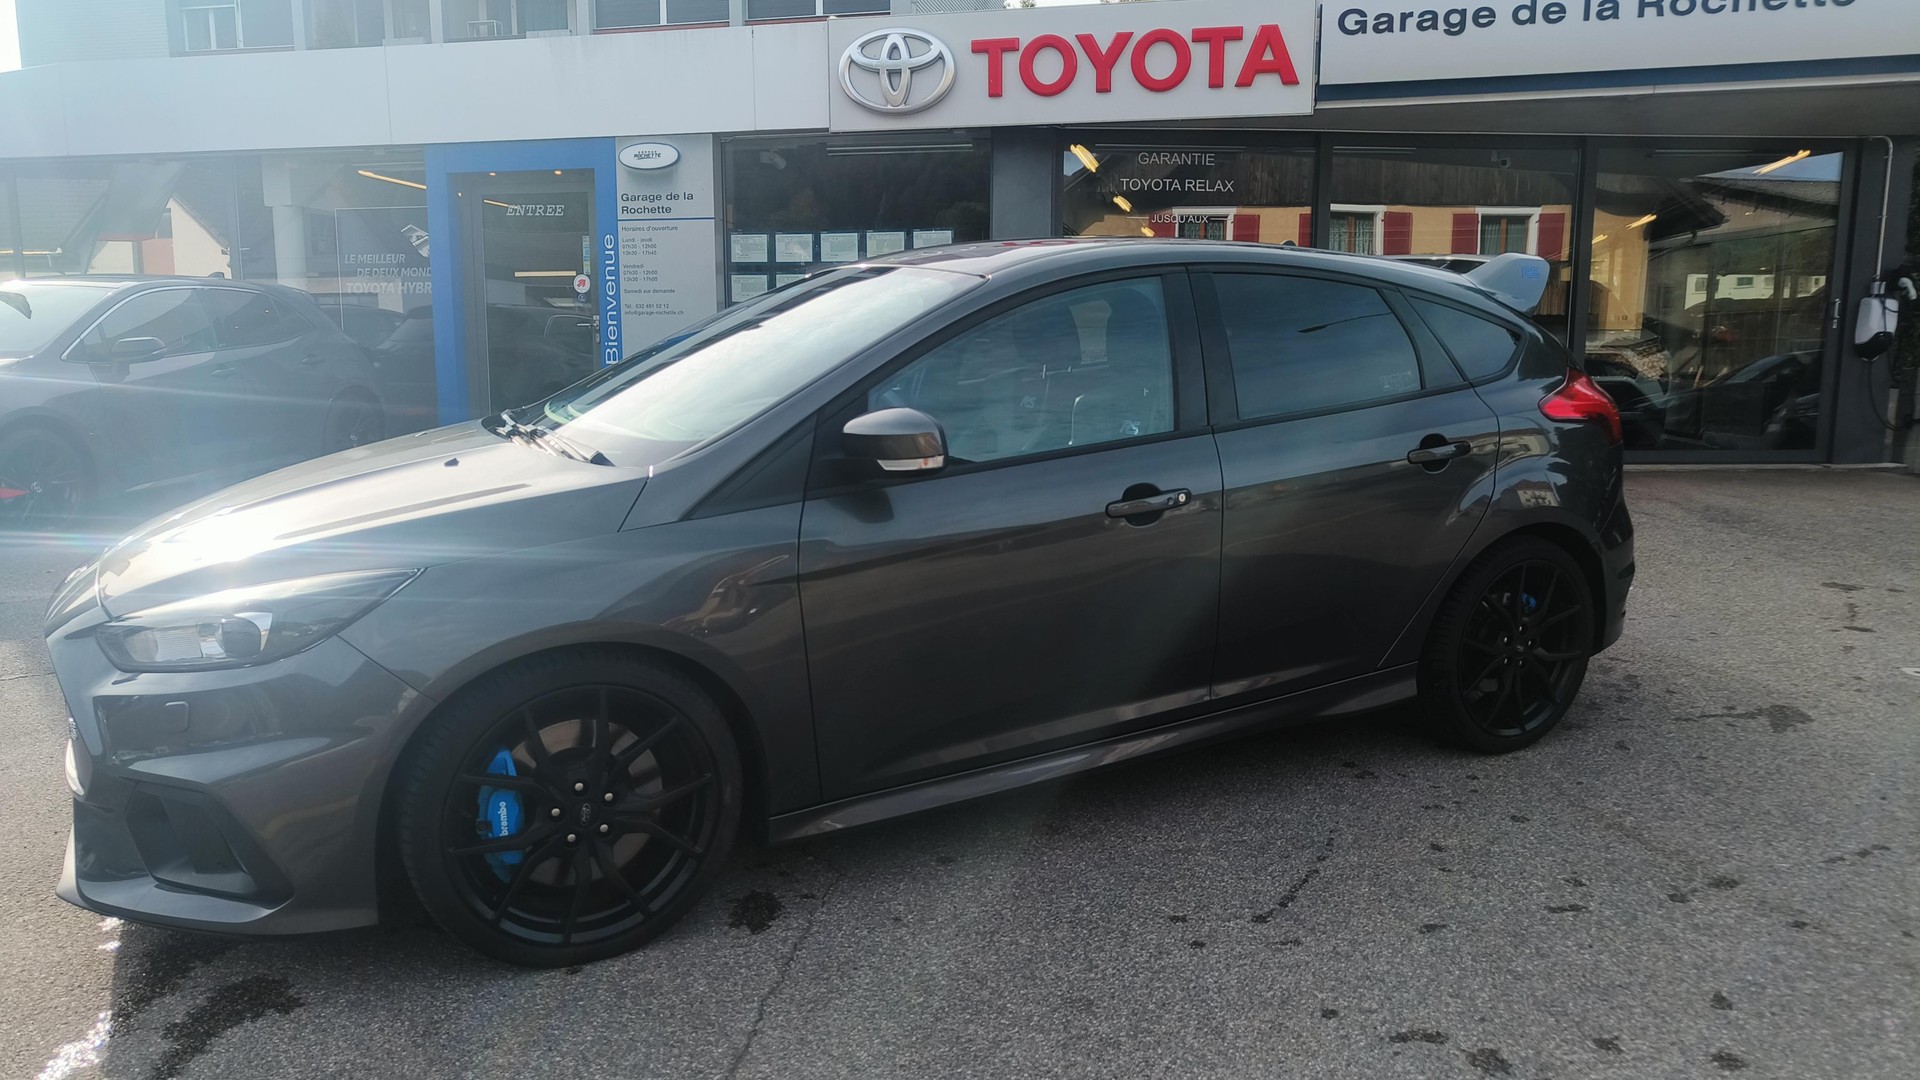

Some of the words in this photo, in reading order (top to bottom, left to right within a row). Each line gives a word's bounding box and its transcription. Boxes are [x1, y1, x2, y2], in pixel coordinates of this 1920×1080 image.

[1337, 6, 1496, 36] Garage
[1511, 0, 1567, 25] de
[1583, 0, 1620, 21] la
[1637, 0, 1855, 18] Roce
[970, 23, 1300, 97] TOYOTA
[1138, 152, 1216, 166] GARANTIE
[1120, 179, 1182, 191] TOYOTA
[1185, 180, 1234, 192] RELAX
[621, 193, 662, 203] Garage
[665, 192, 680, 201] de
[683, 191, 694, 201] la
[506, 204, 565, 217] ENTREE
[621, 205, 672, 215] Rochette
[1152, 214, 1208, 223] JUSQU'AUX
[345, 254, 356, 264] LE
[358, 254, 406, 264] MEILLEUR
[357, 268, 370, 277] DE
[372, 268, 400, 277] DEUX
[346, 282, 395, 294] TOYOTA
[604, 234, 618, 365] Bienvenue
[498, 801, 508, 836] brembo
